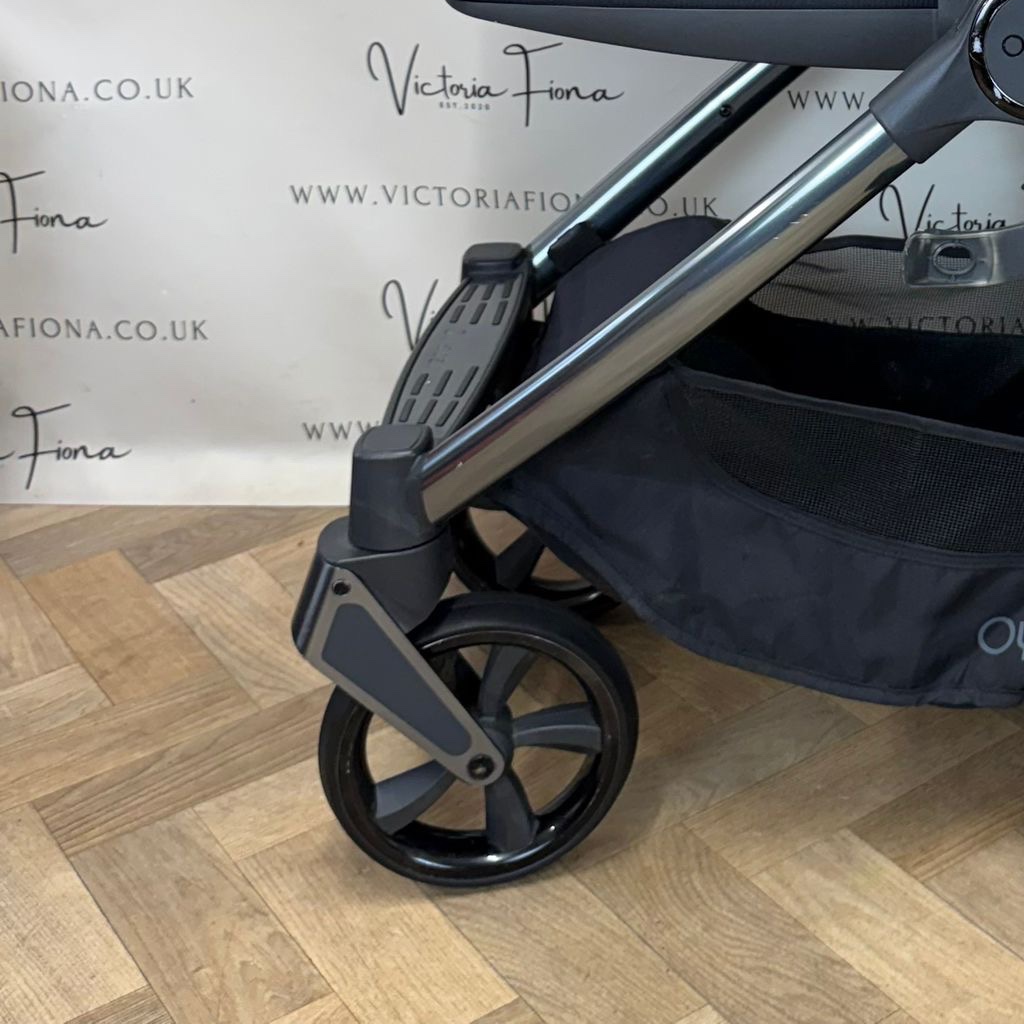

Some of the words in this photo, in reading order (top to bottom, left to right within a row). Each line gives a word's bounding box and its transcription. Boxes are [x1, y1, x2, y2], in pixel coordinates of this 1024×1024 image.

[367, 41, 509, 116] Victoria
[502, 42, 625, 127] Fiona
[11, 403, 132, 490] Fiona
